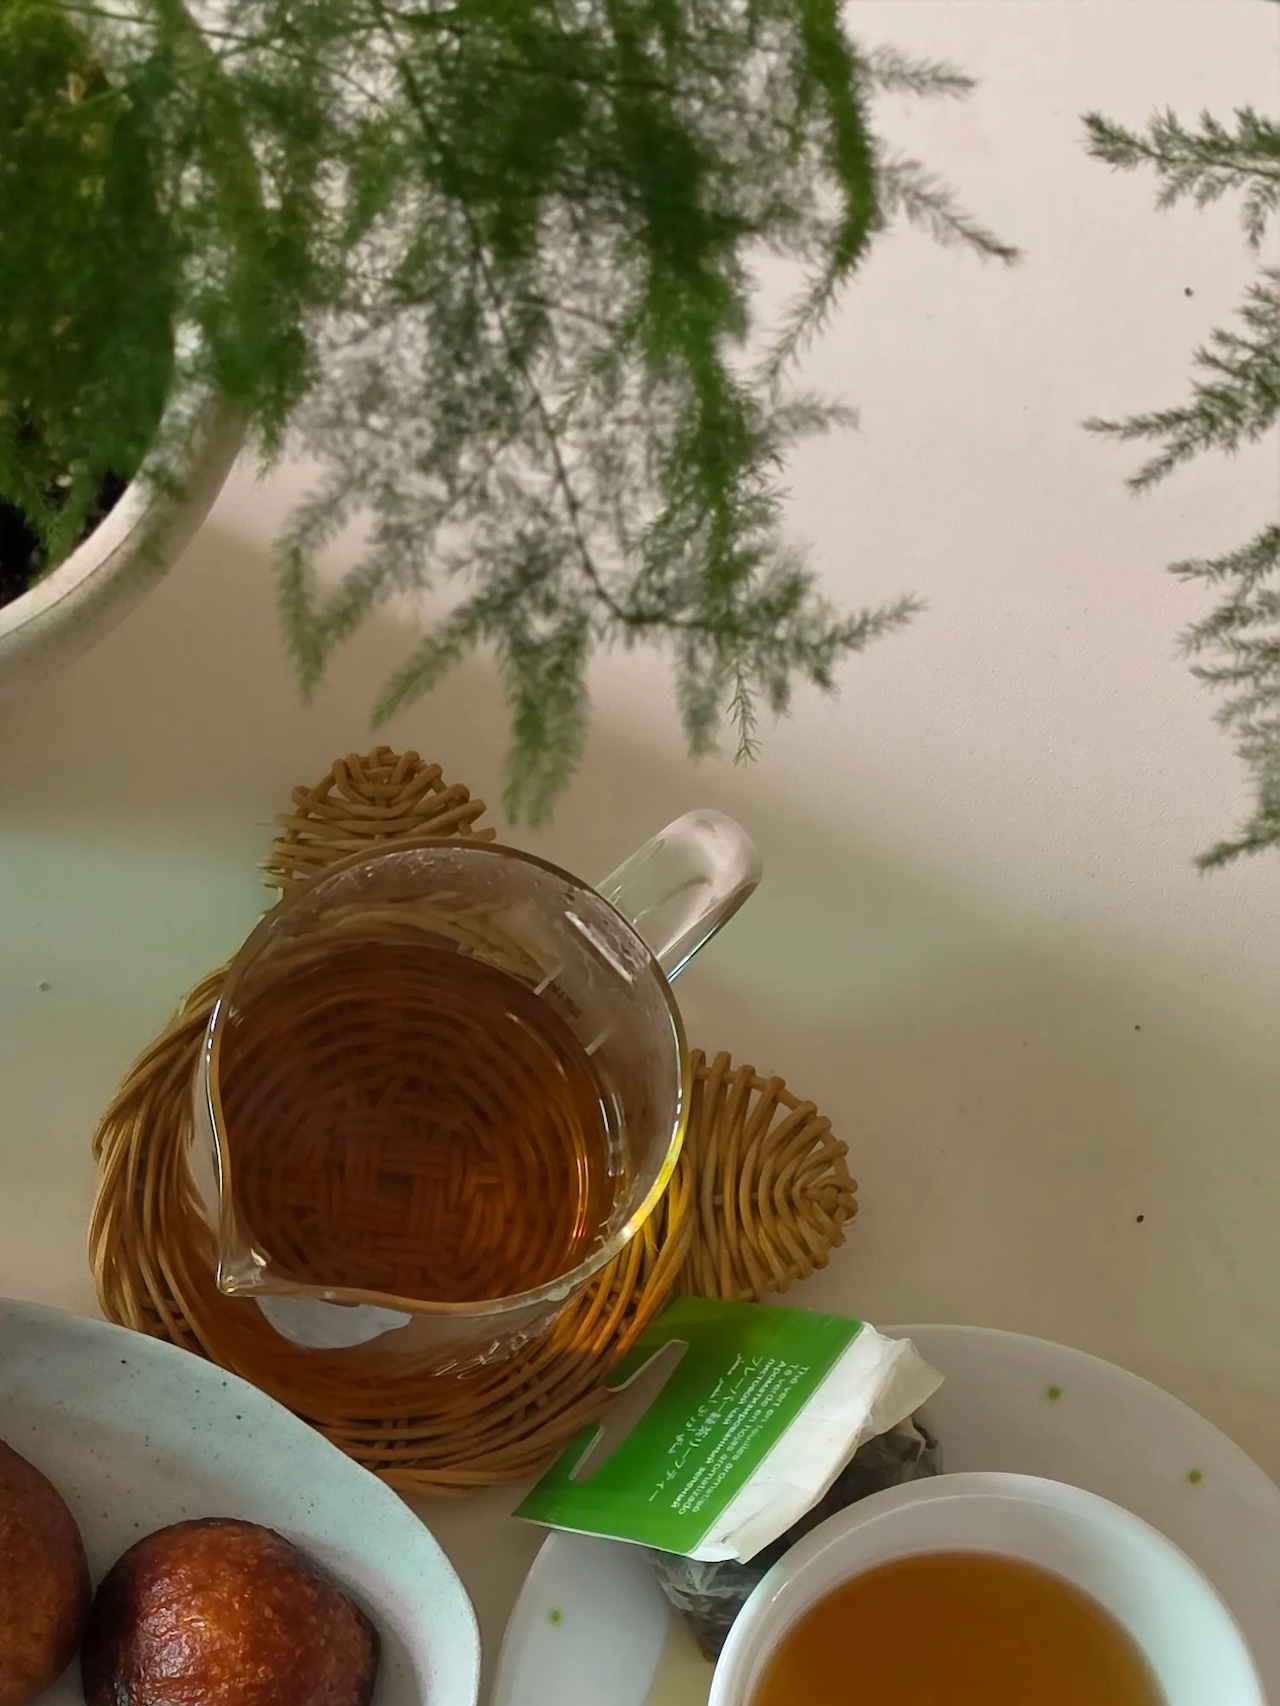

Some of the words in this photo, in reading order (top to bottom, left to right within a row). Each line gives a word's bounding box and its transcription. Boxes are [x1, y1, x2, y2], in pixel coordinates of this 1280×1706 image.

[761, 1379, 785, 1407] verde
[773, 1388, 790, 1406] vert
[727, 1425, 750, 1451] hojas
